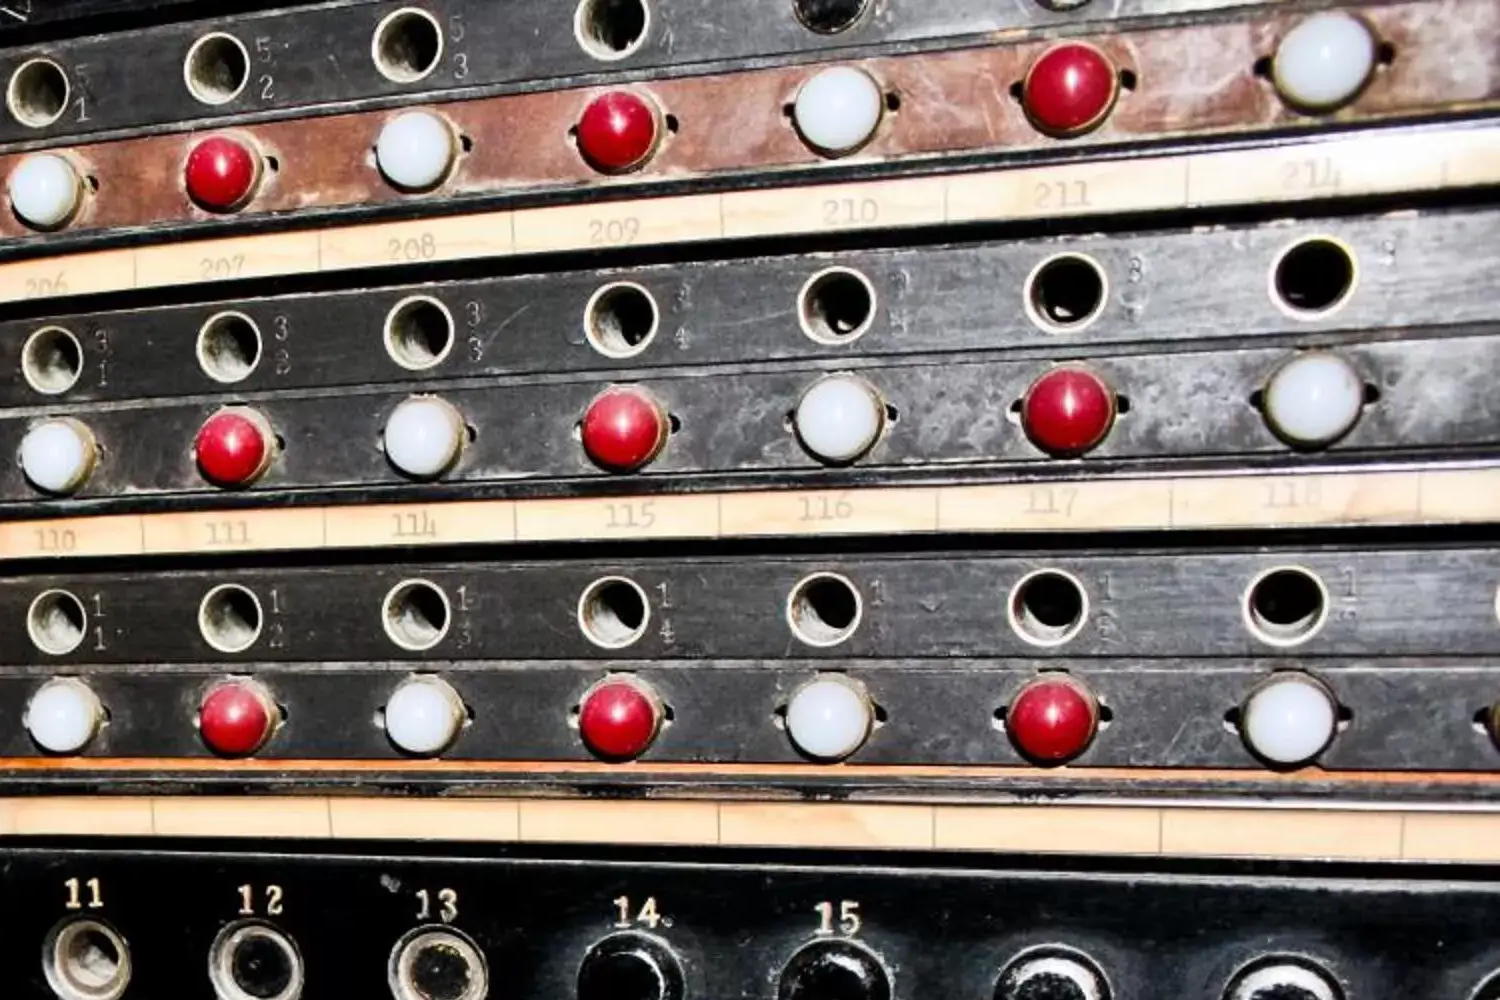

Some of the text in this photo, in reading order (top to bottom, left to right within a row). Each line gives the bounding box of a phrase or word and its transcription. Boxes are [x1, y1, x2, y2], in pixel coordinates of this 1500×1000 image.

[259, 74, 275, 100] 2
[454, 53, 468, 79] 3
[25, 156, 1343, 296] 206 207 208 209 210 211 214
[274, 315, 287, 341] 3
[465, 301, 481, 326] 3
[467, 336, 483, 362] 3
[34, 527, 77, 551] 110
[204, 519, 253, 545] 111
[391, 508, 438, 537] 114
[605, 500, 656, 530] 115
[797, 491, 855, 521] 116
[1023, 487, 1078, 518] 117
[92, 593, 106, 616] 1
[456, 585, 469, 611] 1
[655, 582, 672, 608] 1
[65, 878, 861, 935] 11 12 13 14 15
